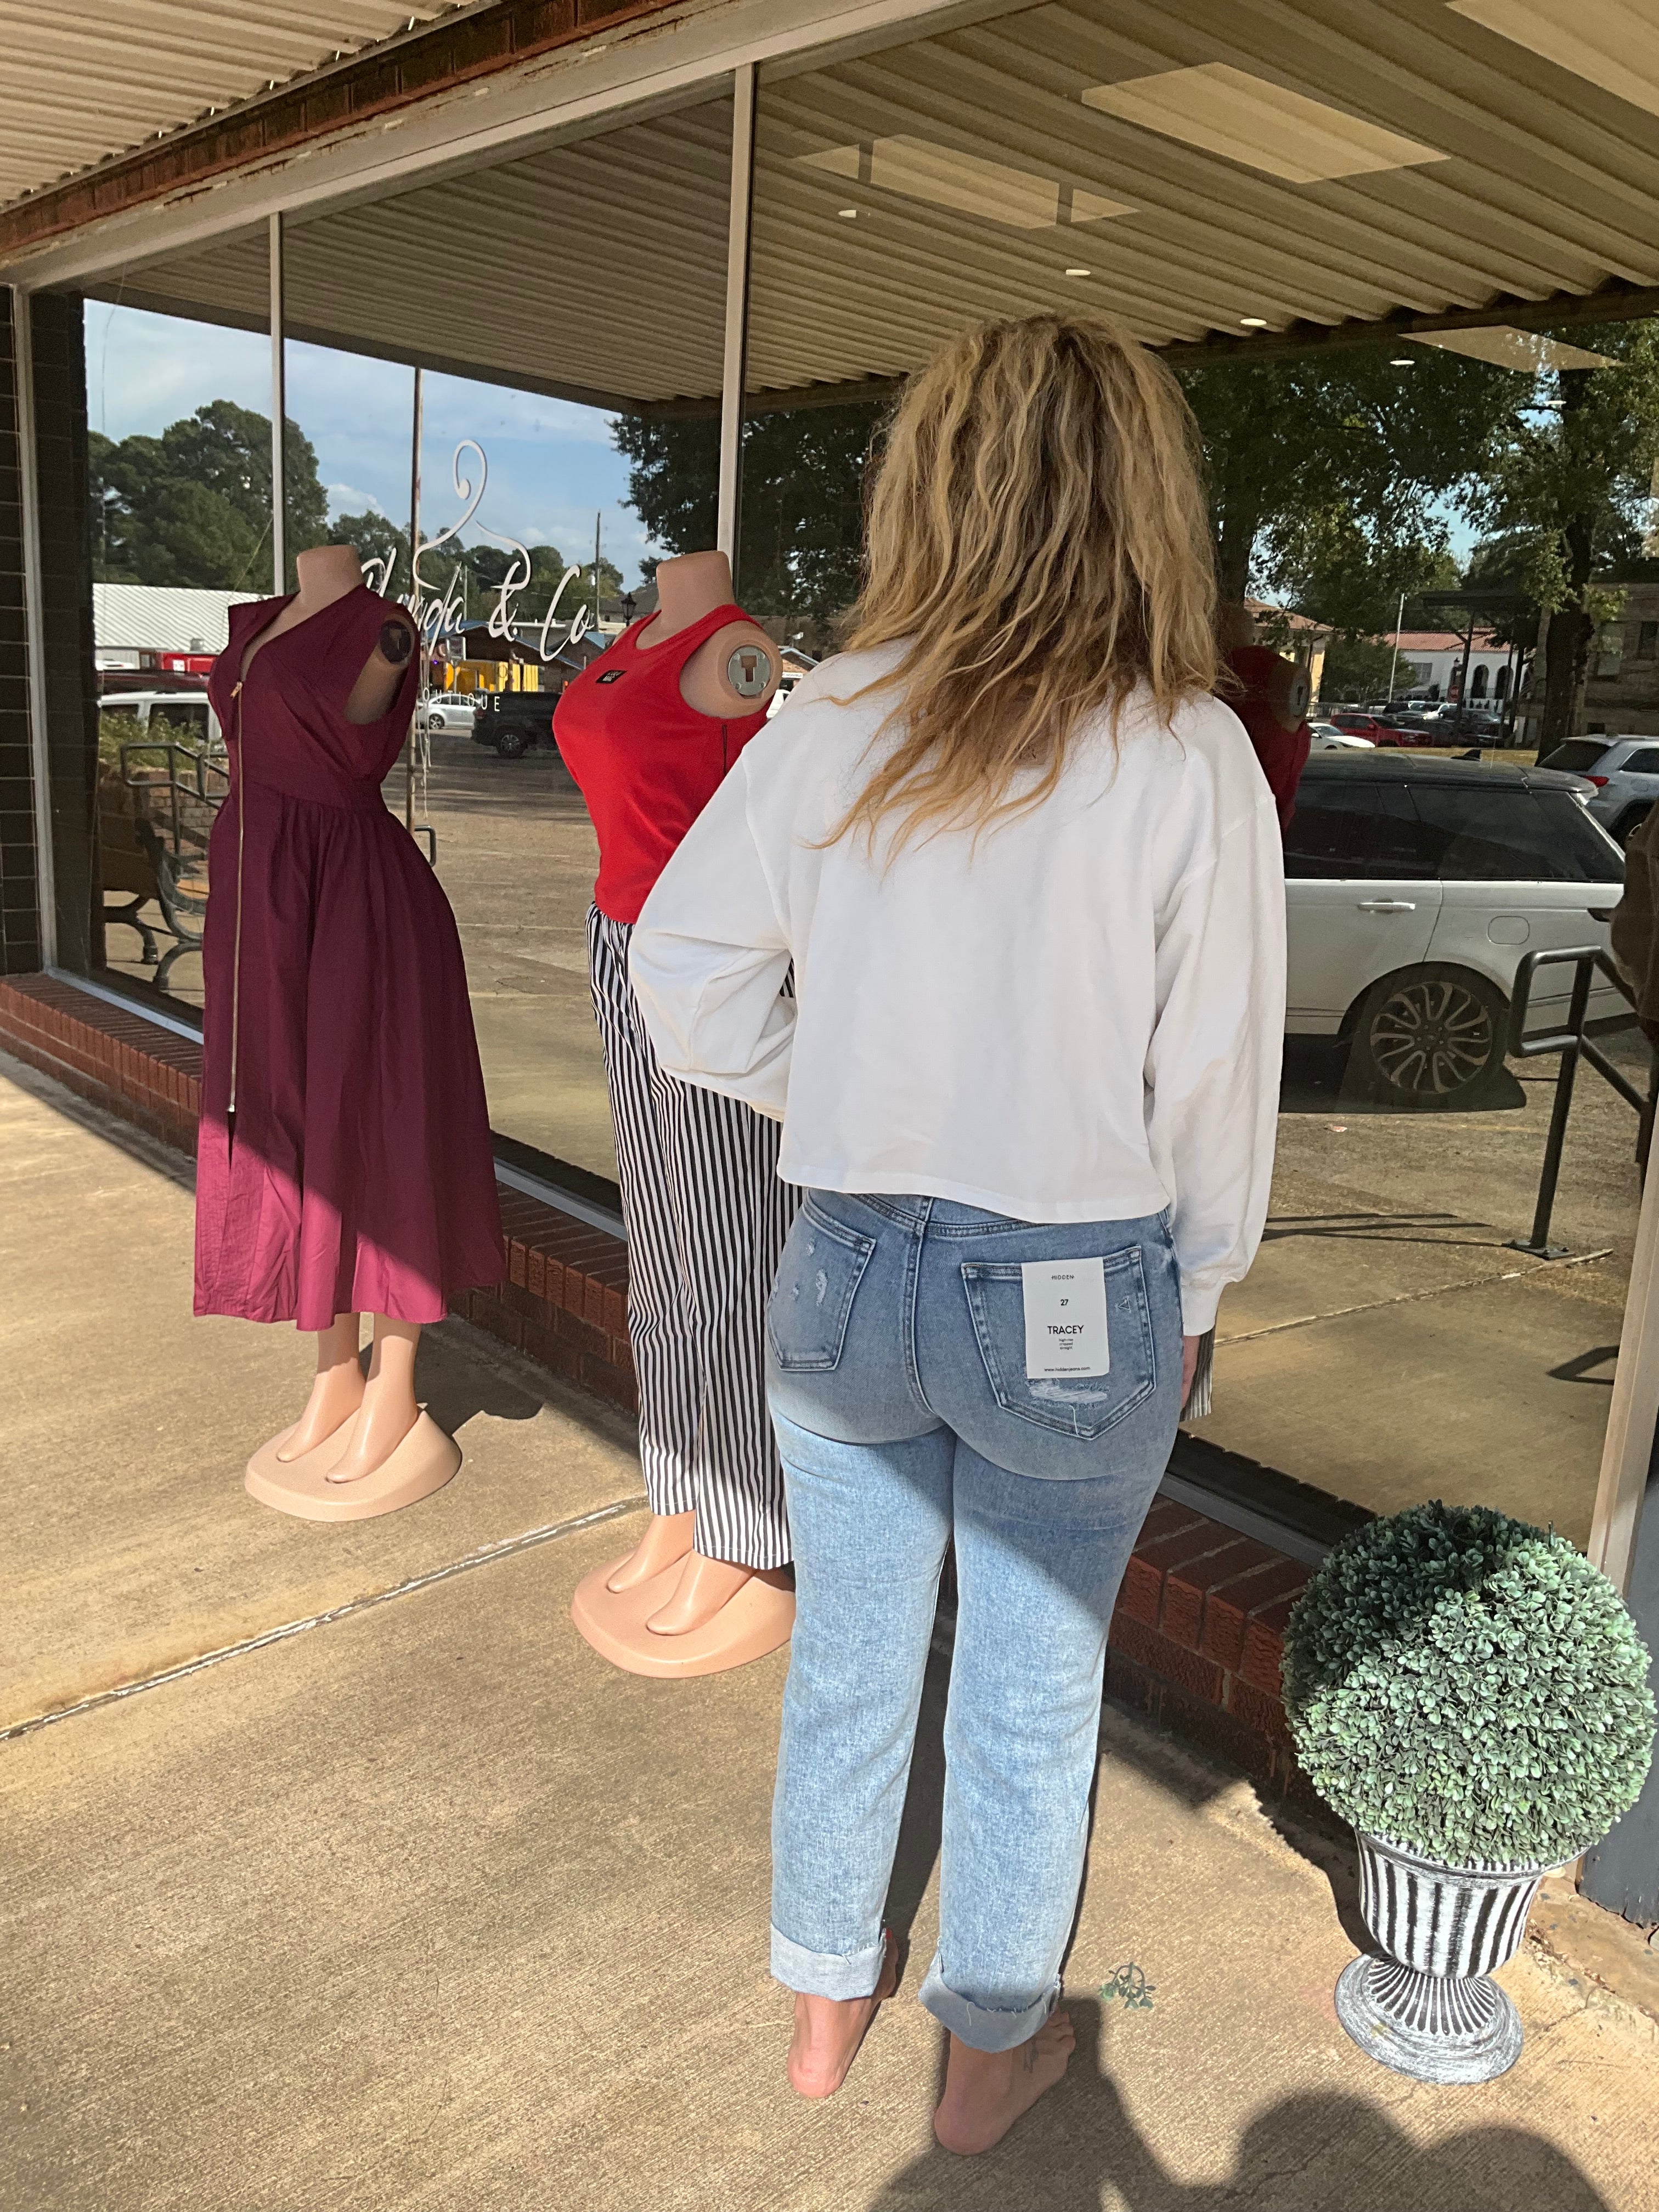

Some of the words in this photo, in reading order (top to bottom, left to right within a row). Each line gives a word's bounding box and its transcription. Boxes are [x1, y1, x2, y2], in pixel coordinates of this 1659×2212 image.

[488, 561, 521, 642] &
[539, 565, 595, 662] Co
[423, 687, 500, 712] OUTIQUE
[1047, 1325, 1084, 1335] TRACEY
